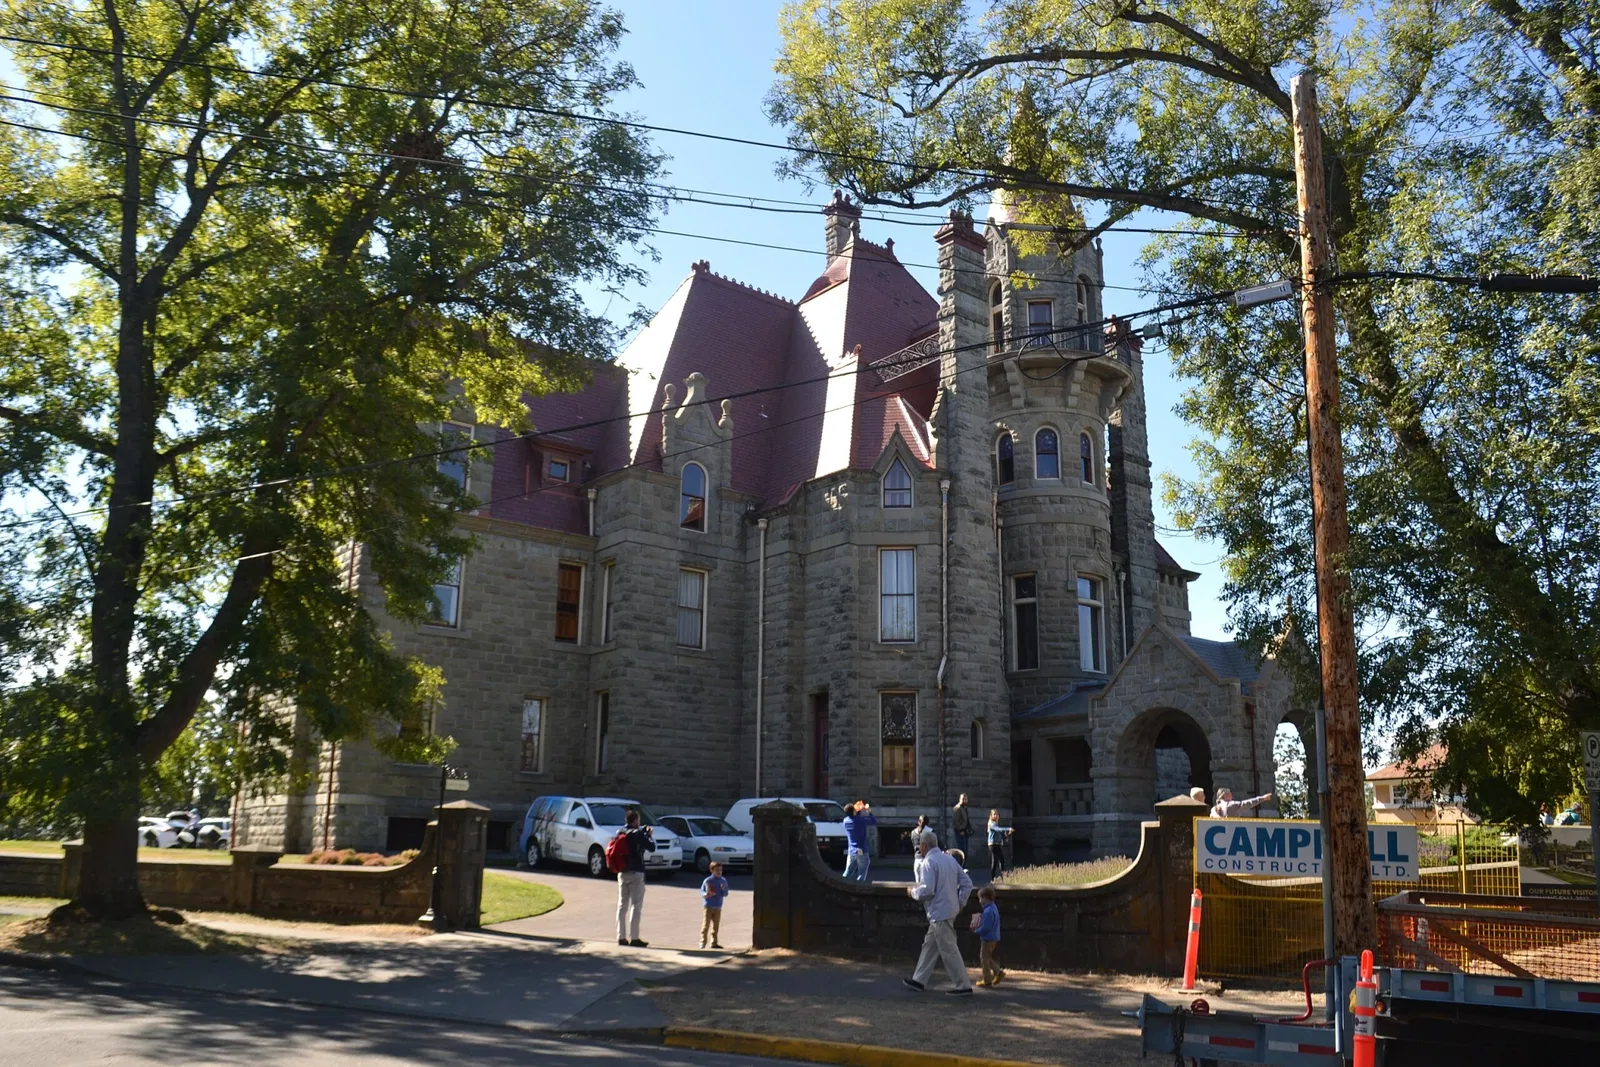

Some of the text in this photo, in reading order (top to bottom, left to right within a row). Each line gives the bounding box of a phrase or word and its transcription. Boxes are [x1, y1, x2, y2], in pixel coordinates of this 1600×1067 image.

[1204, 825, 1409, 862] CAMPLL
[1205, 858, 1410, 877] CONSTRUCT LTD.
[1545, 888, 1571, 896] FUTURE
